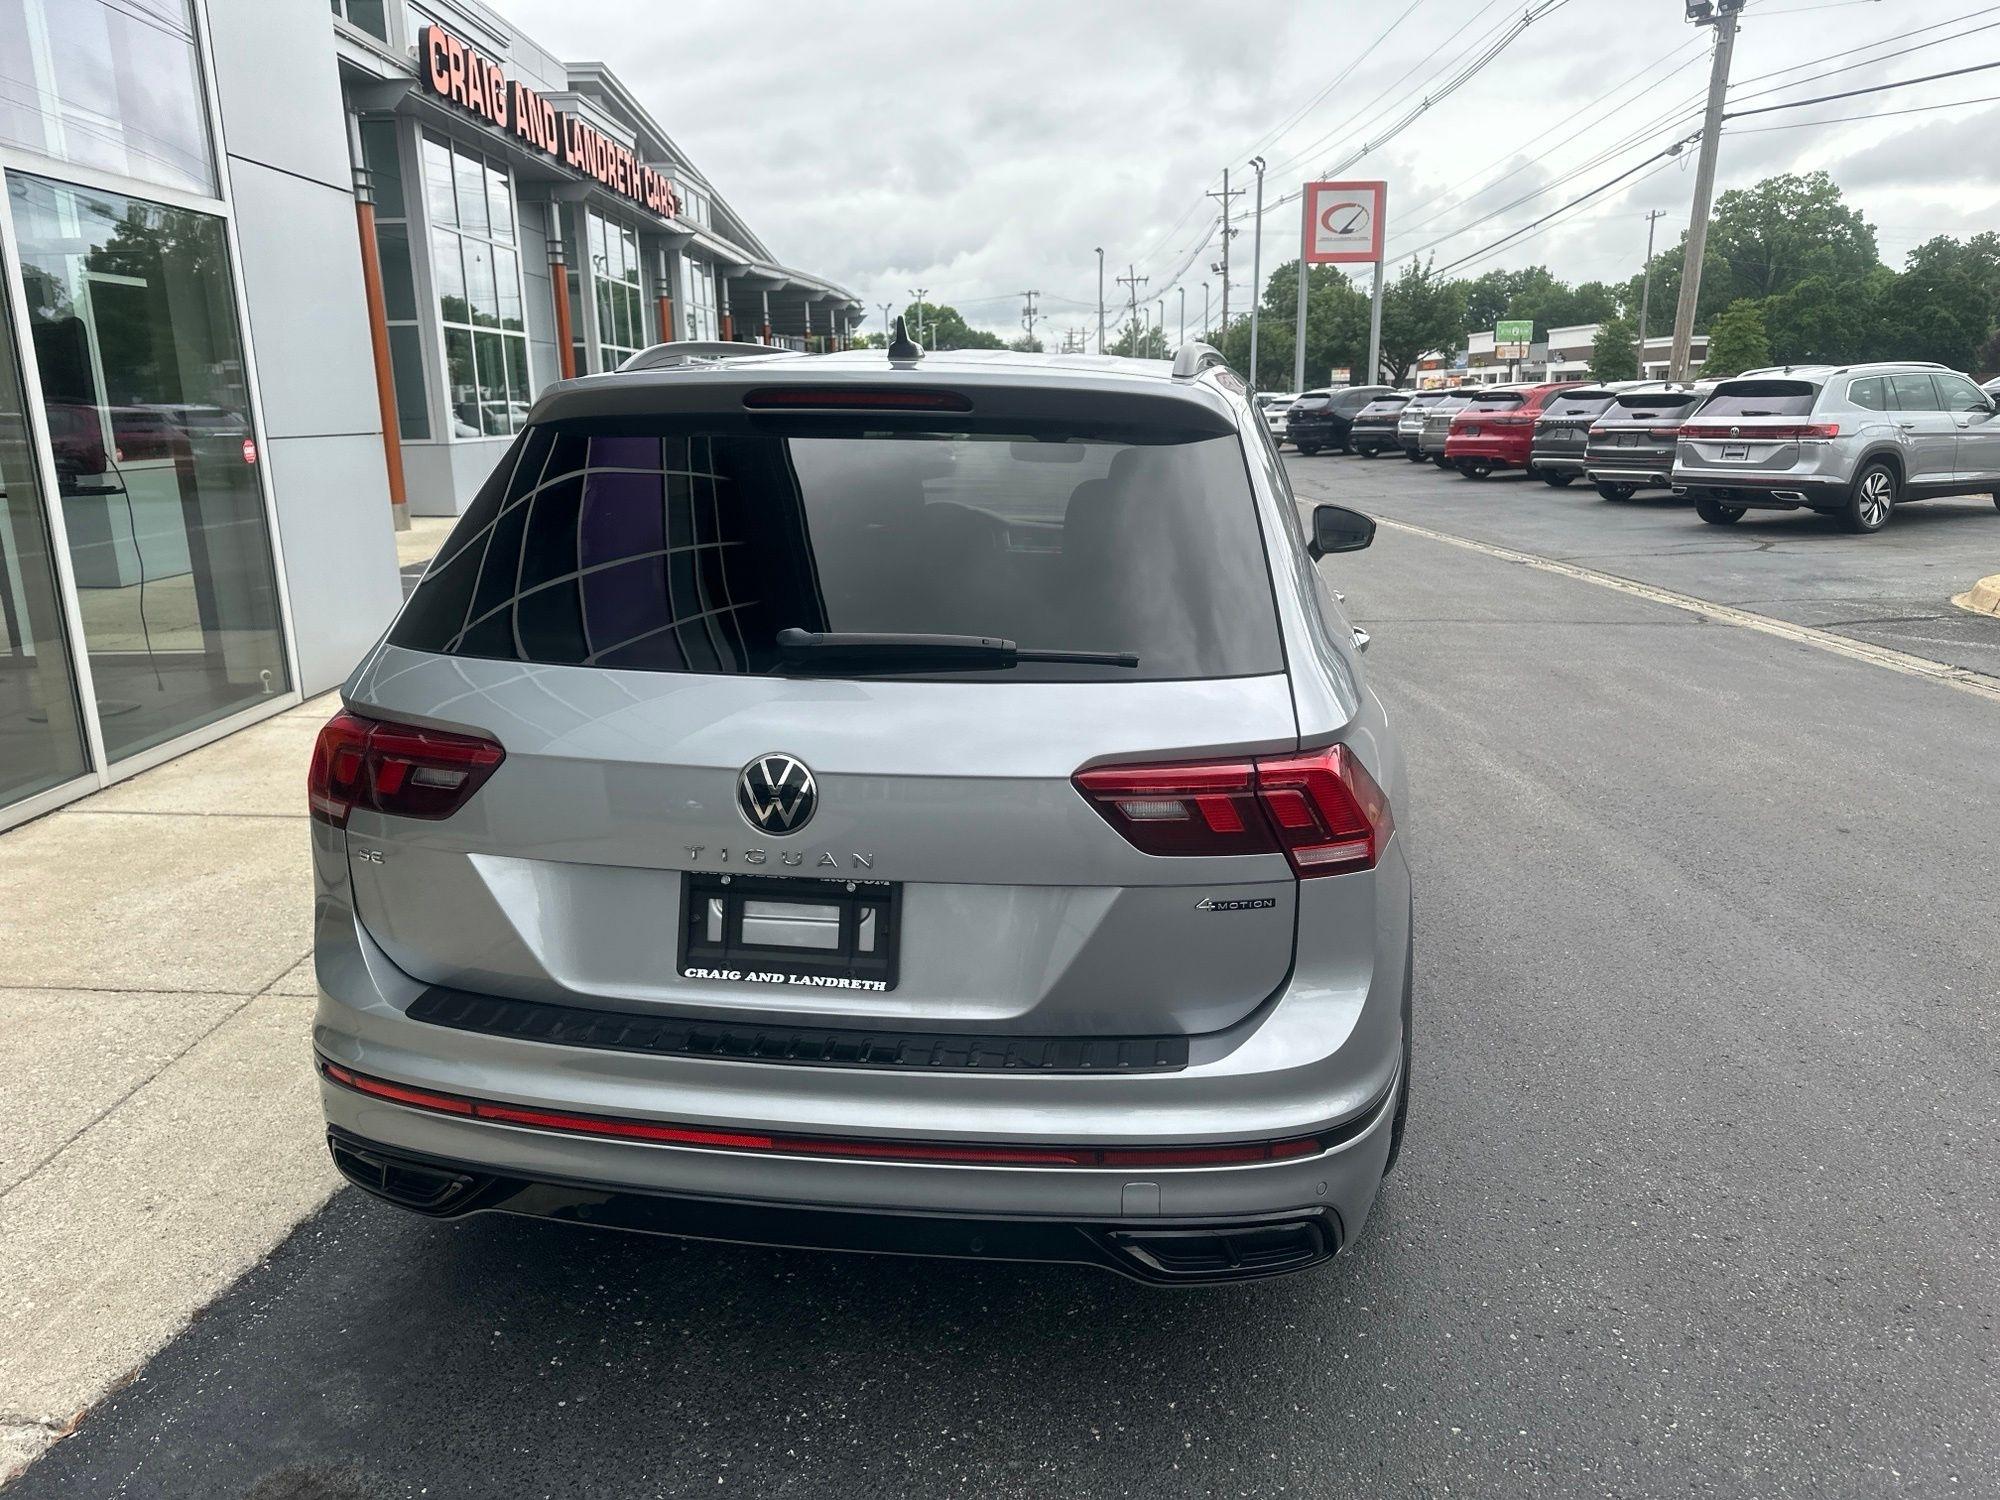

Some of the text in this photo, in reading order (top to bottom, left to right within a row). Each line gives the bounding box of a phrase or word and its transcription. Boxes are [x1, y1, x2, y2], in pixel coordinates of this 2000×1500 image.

[424, 24, 676, 219] CRAIG AND LANDRETH CARS
[684, 843, 874, 870] TIGUAN
[1195, 898, 1274, 911] 4MOTION
[684, 967, 887, 991] CRAIG AND LANDRETH
